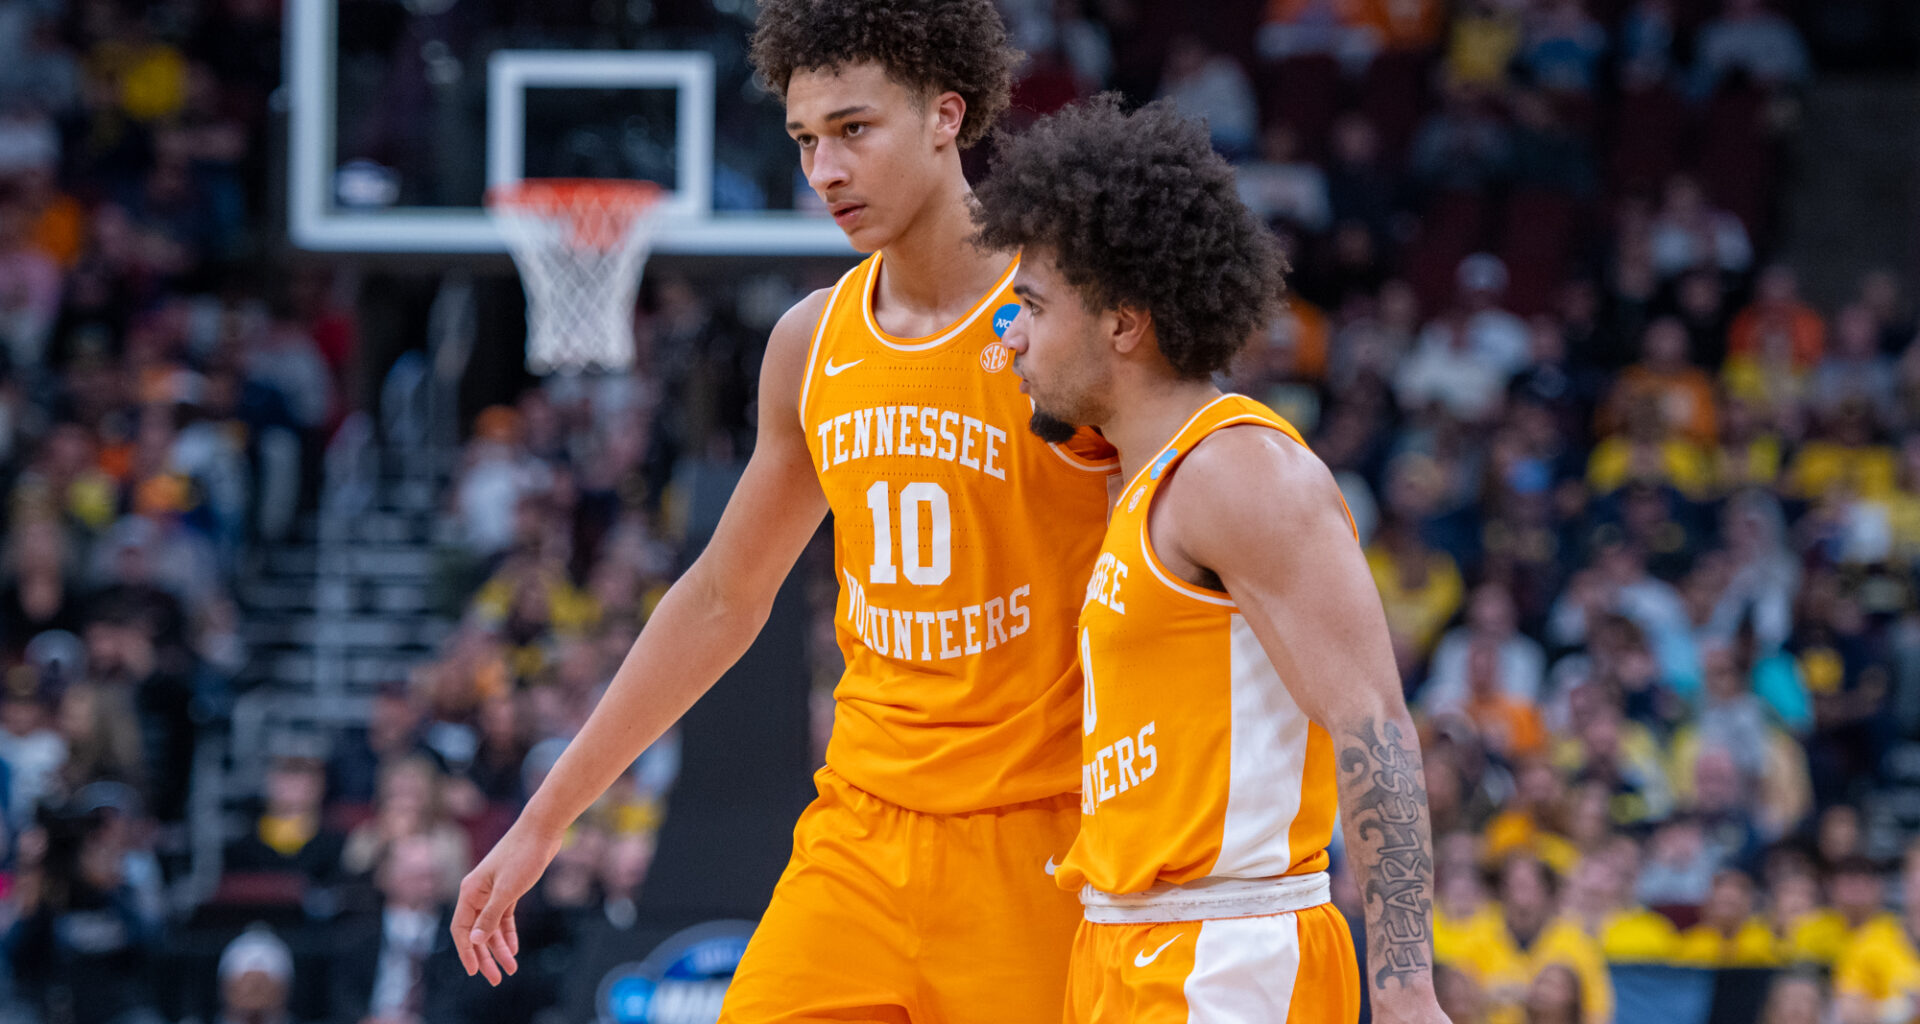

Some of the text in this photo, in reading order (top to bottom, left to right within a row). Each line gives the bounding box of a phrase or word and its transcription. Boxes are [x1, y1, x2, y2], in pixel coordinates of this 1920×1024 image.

[983, 345, 1006, 370] SEC
[817, 405, 1007, 481] TENNESSEE
[866, 480, 952, 586] 10
[842, 566, 1031, 662] VOLUNTEERS
[1371, 743, 1429, 974] FEARLESS
